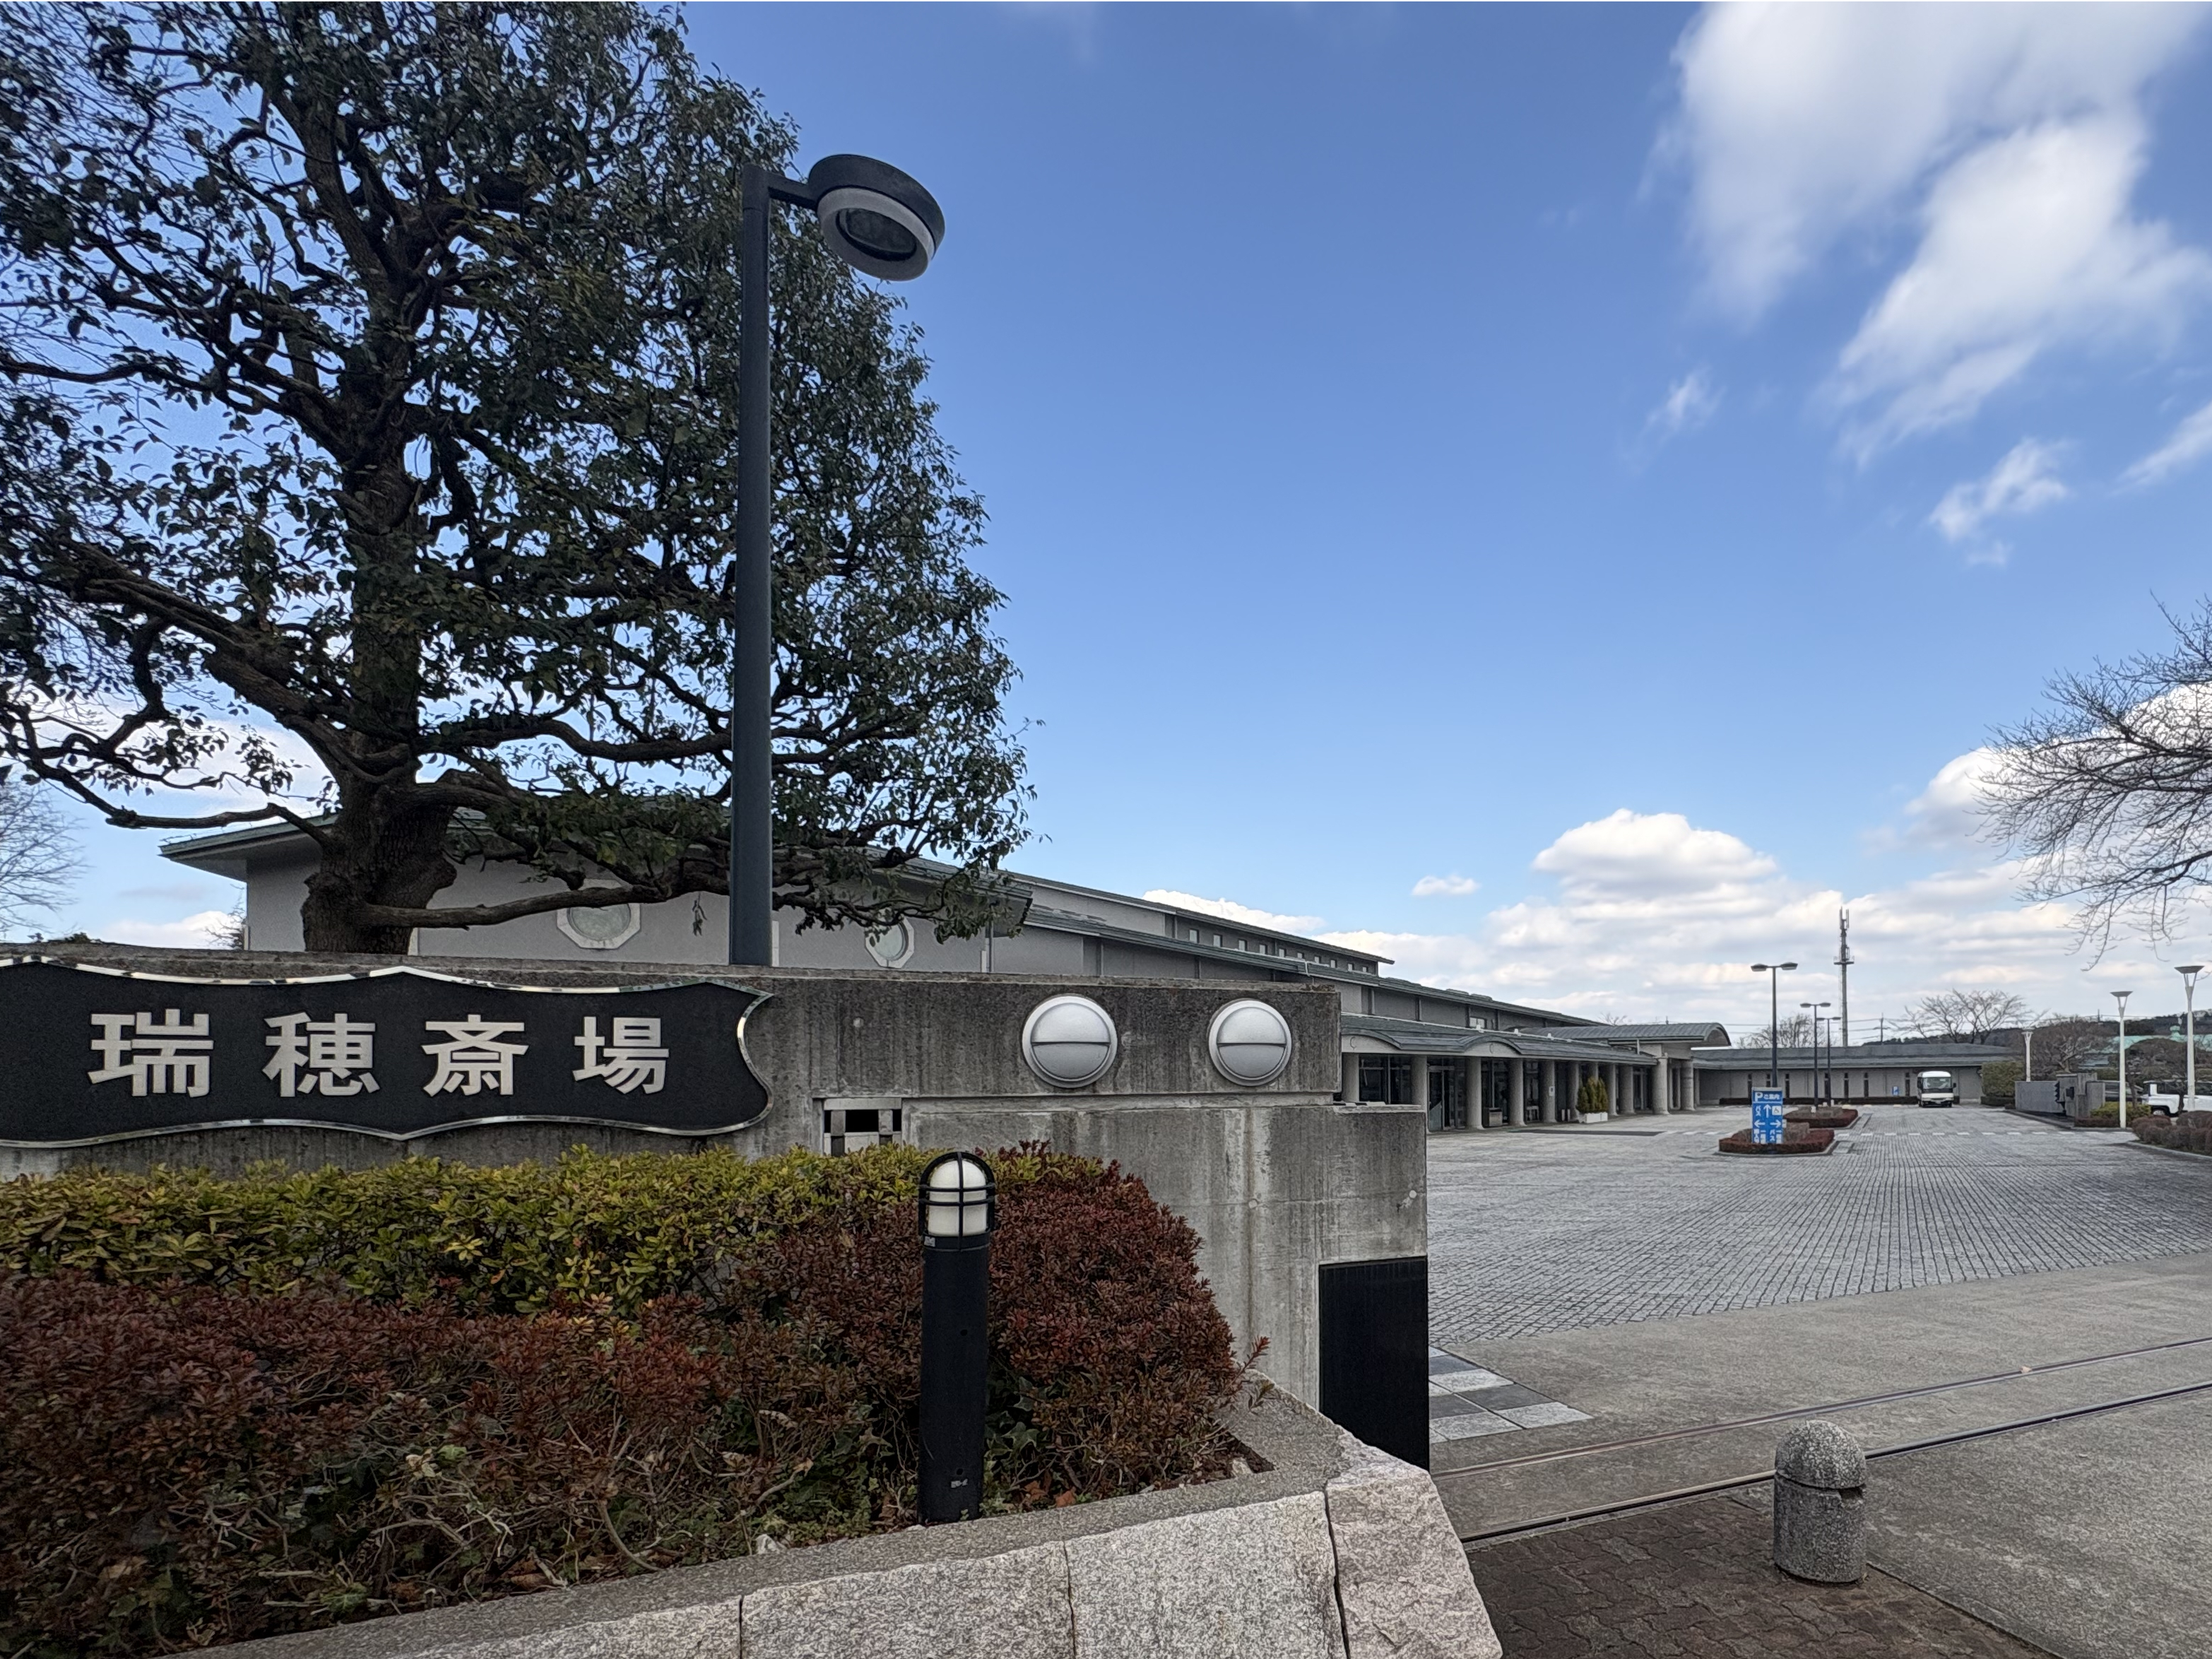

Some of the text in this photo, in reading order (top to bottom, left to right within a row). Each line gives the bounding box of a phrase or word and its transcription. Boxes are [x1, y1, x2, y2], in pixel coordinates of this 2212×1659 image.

[88, 1008, 669, 1097] 瑞穂斎場
[1755, 1092, 1763, 1102] P
